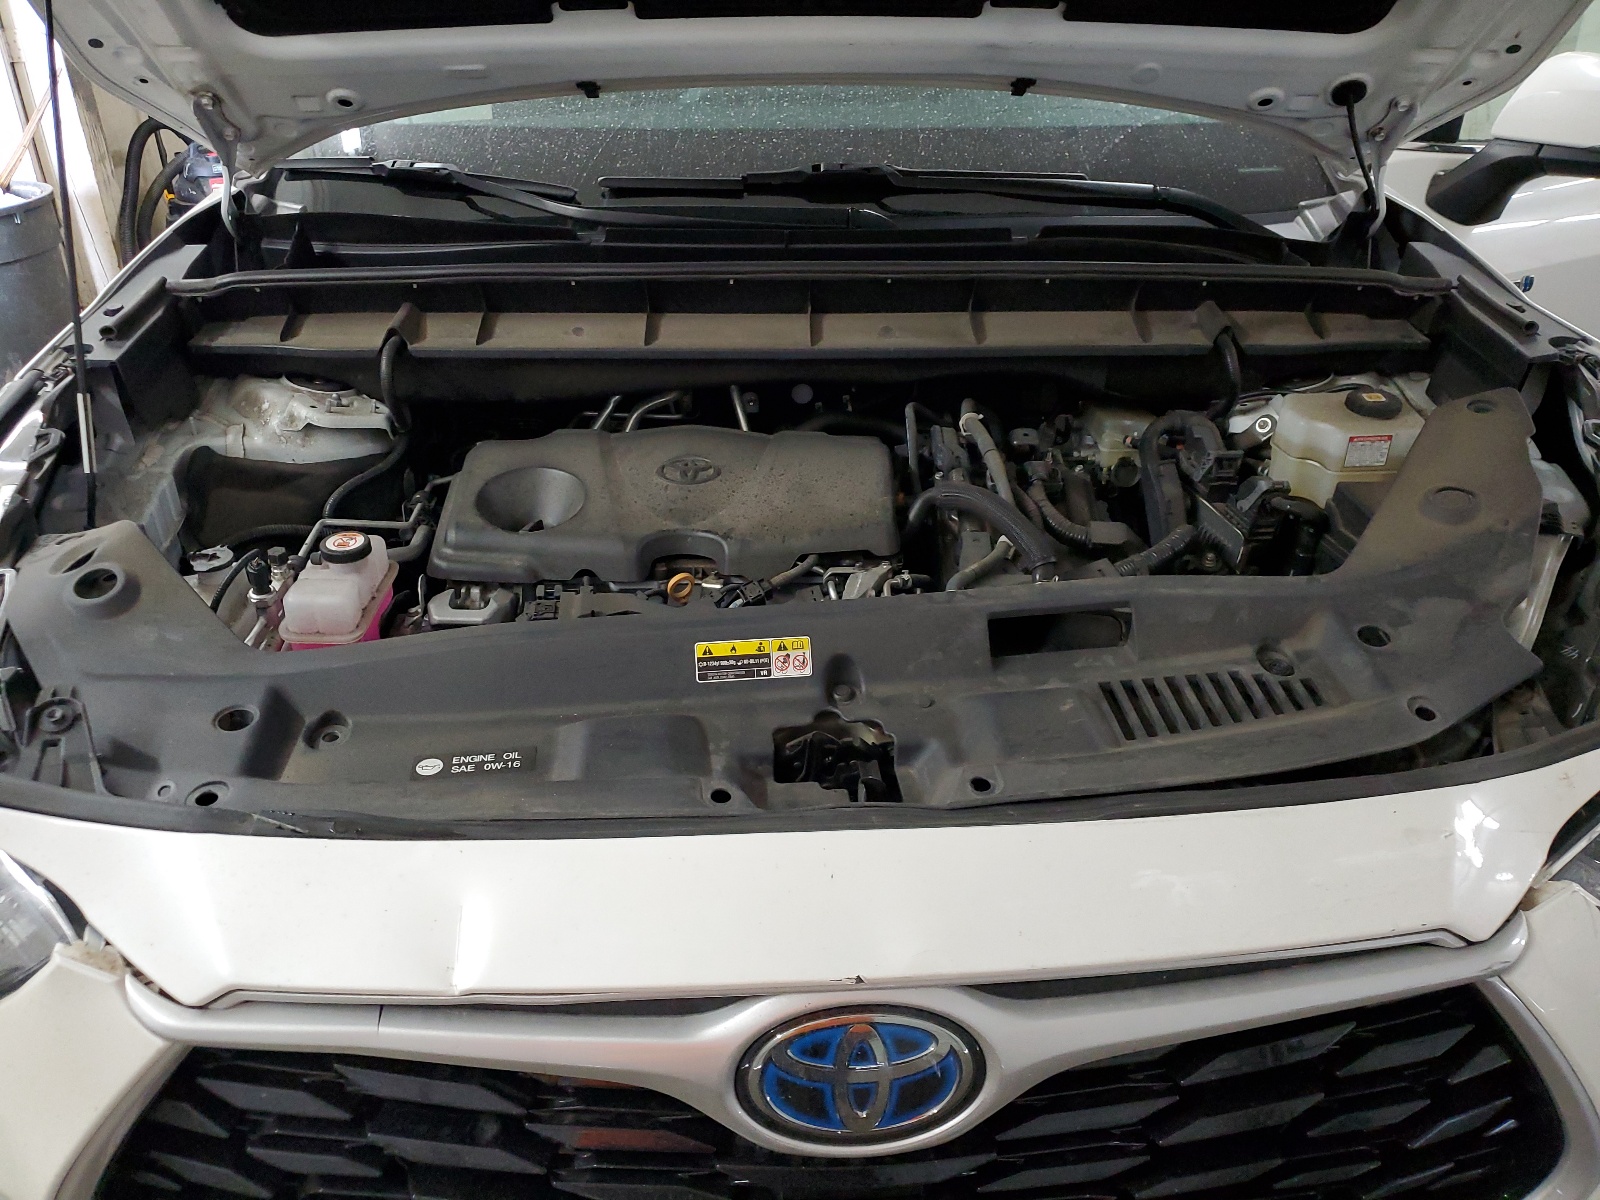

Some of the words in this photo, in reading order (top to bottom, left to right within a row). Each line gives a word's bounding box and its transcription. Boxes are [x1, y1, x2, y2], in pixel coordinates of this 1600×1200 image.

[452, 754, 495, 764] ENGINE
[503, 752, 522, 760] OIL
[451, 764, 475, 773] SAE
[484, 761, 520, 770] 0W-16
